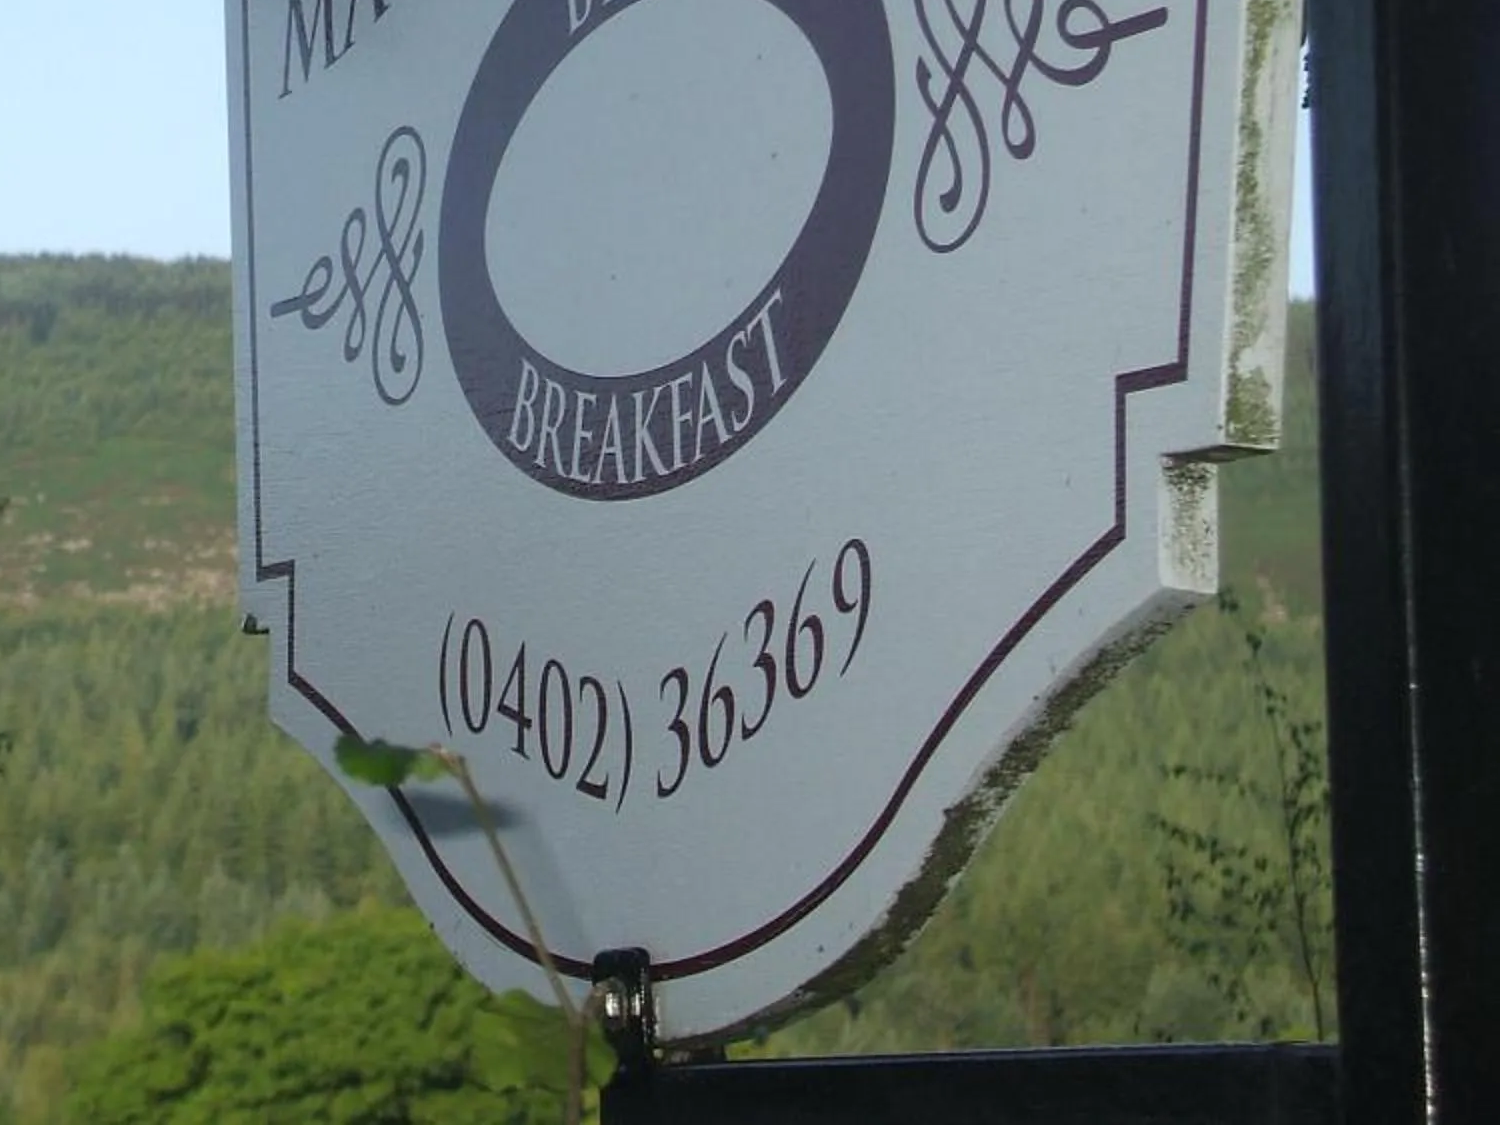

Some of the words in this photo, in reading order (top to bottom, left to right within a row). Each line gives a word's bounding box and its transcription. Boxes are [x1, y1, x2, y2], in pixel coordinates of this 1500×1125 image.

[506, 288, 788, 485] BREAKFAST
[438, 610, 634, 815] (0402)
[656, 537, 872, 799] 36369
